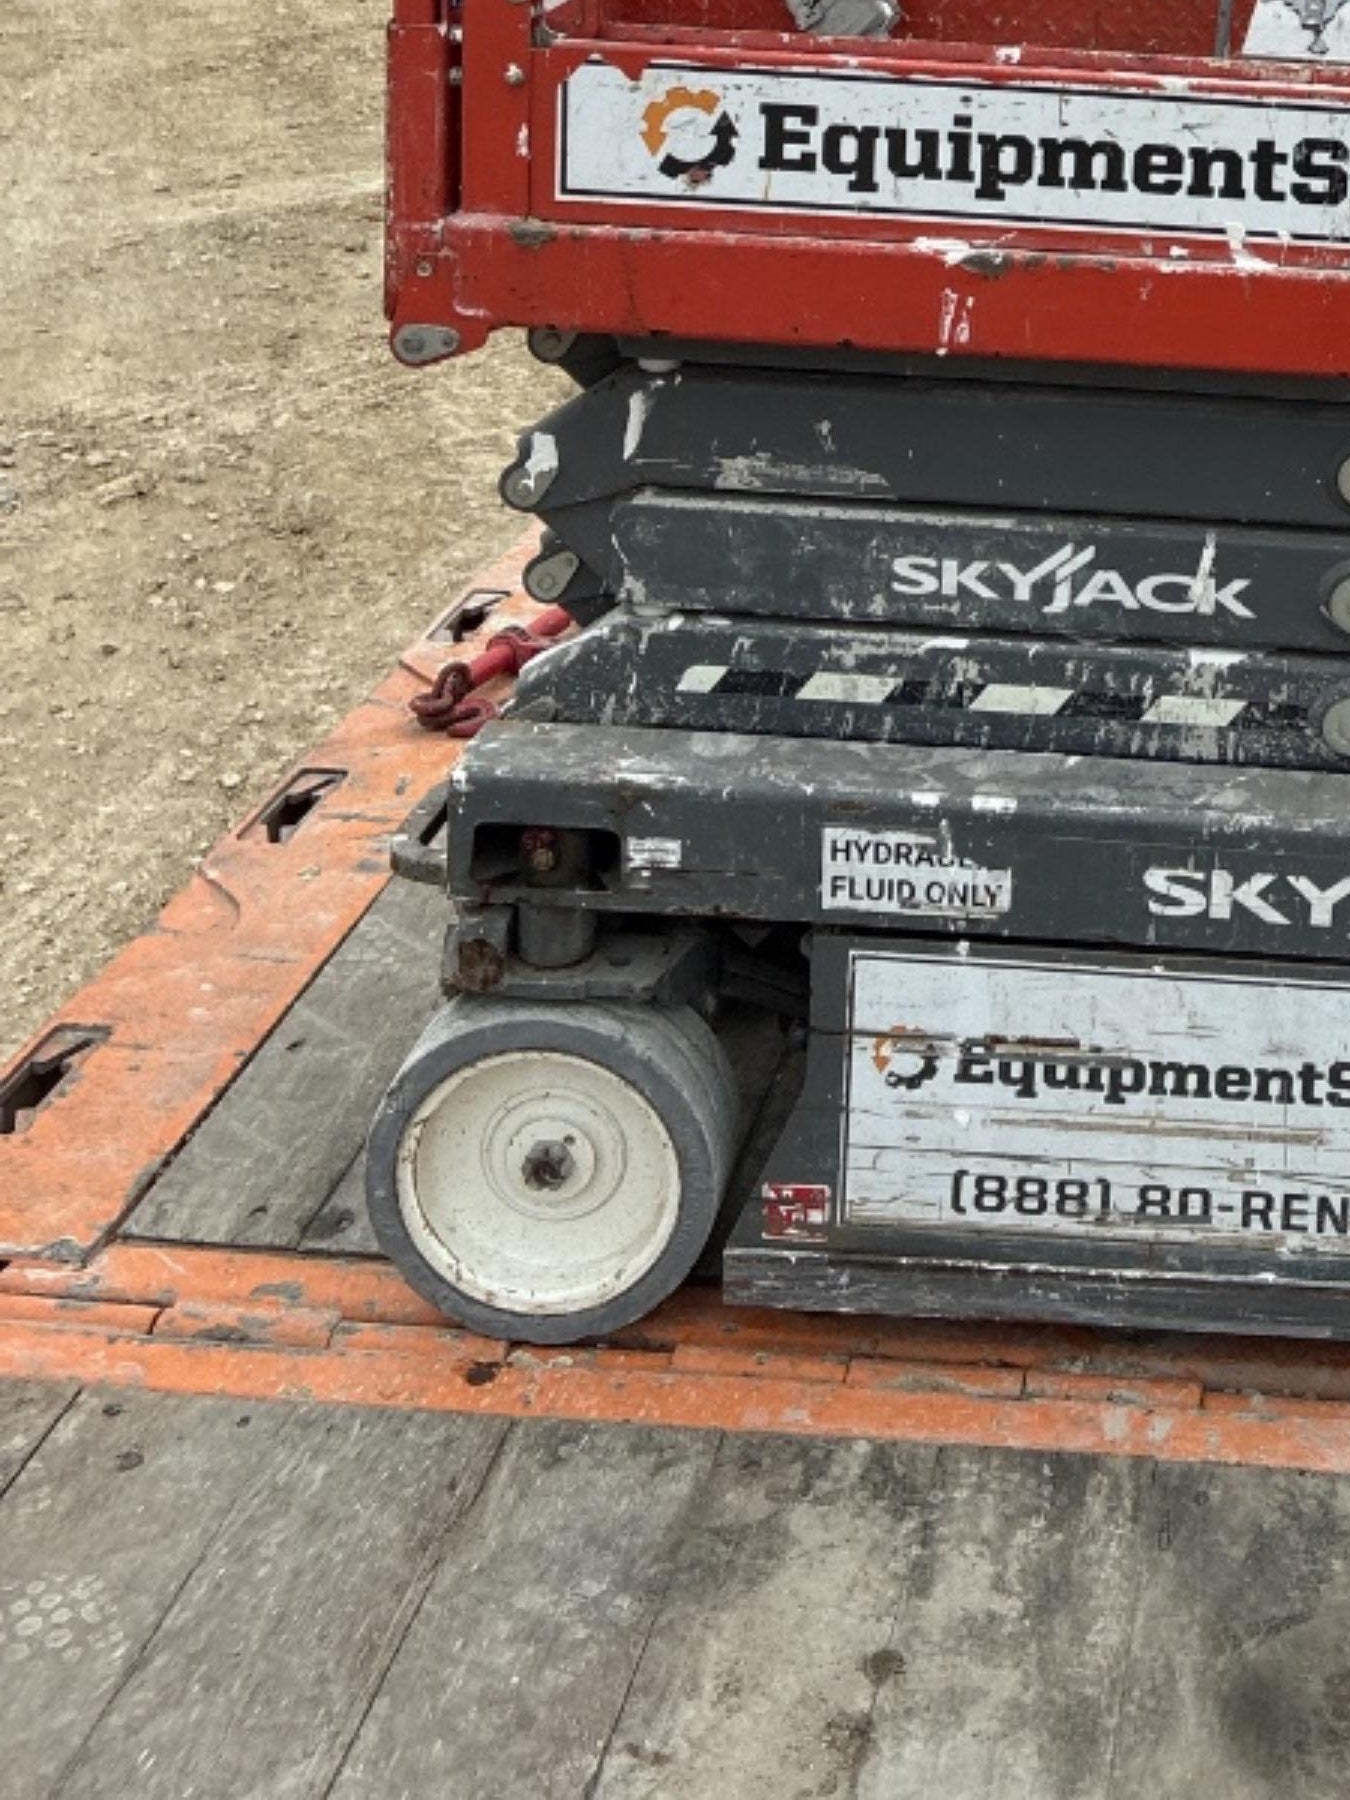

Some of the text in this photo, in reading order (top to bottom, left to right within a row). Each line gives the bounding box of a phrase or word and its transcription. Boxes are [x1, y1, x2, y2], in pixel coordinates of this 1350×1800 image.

[891, 542, 1257, 619] SKYJACK
[830, 876, 1004, 908] FLUID ONLY
[950, 1169, 1113, 1220] (888)
